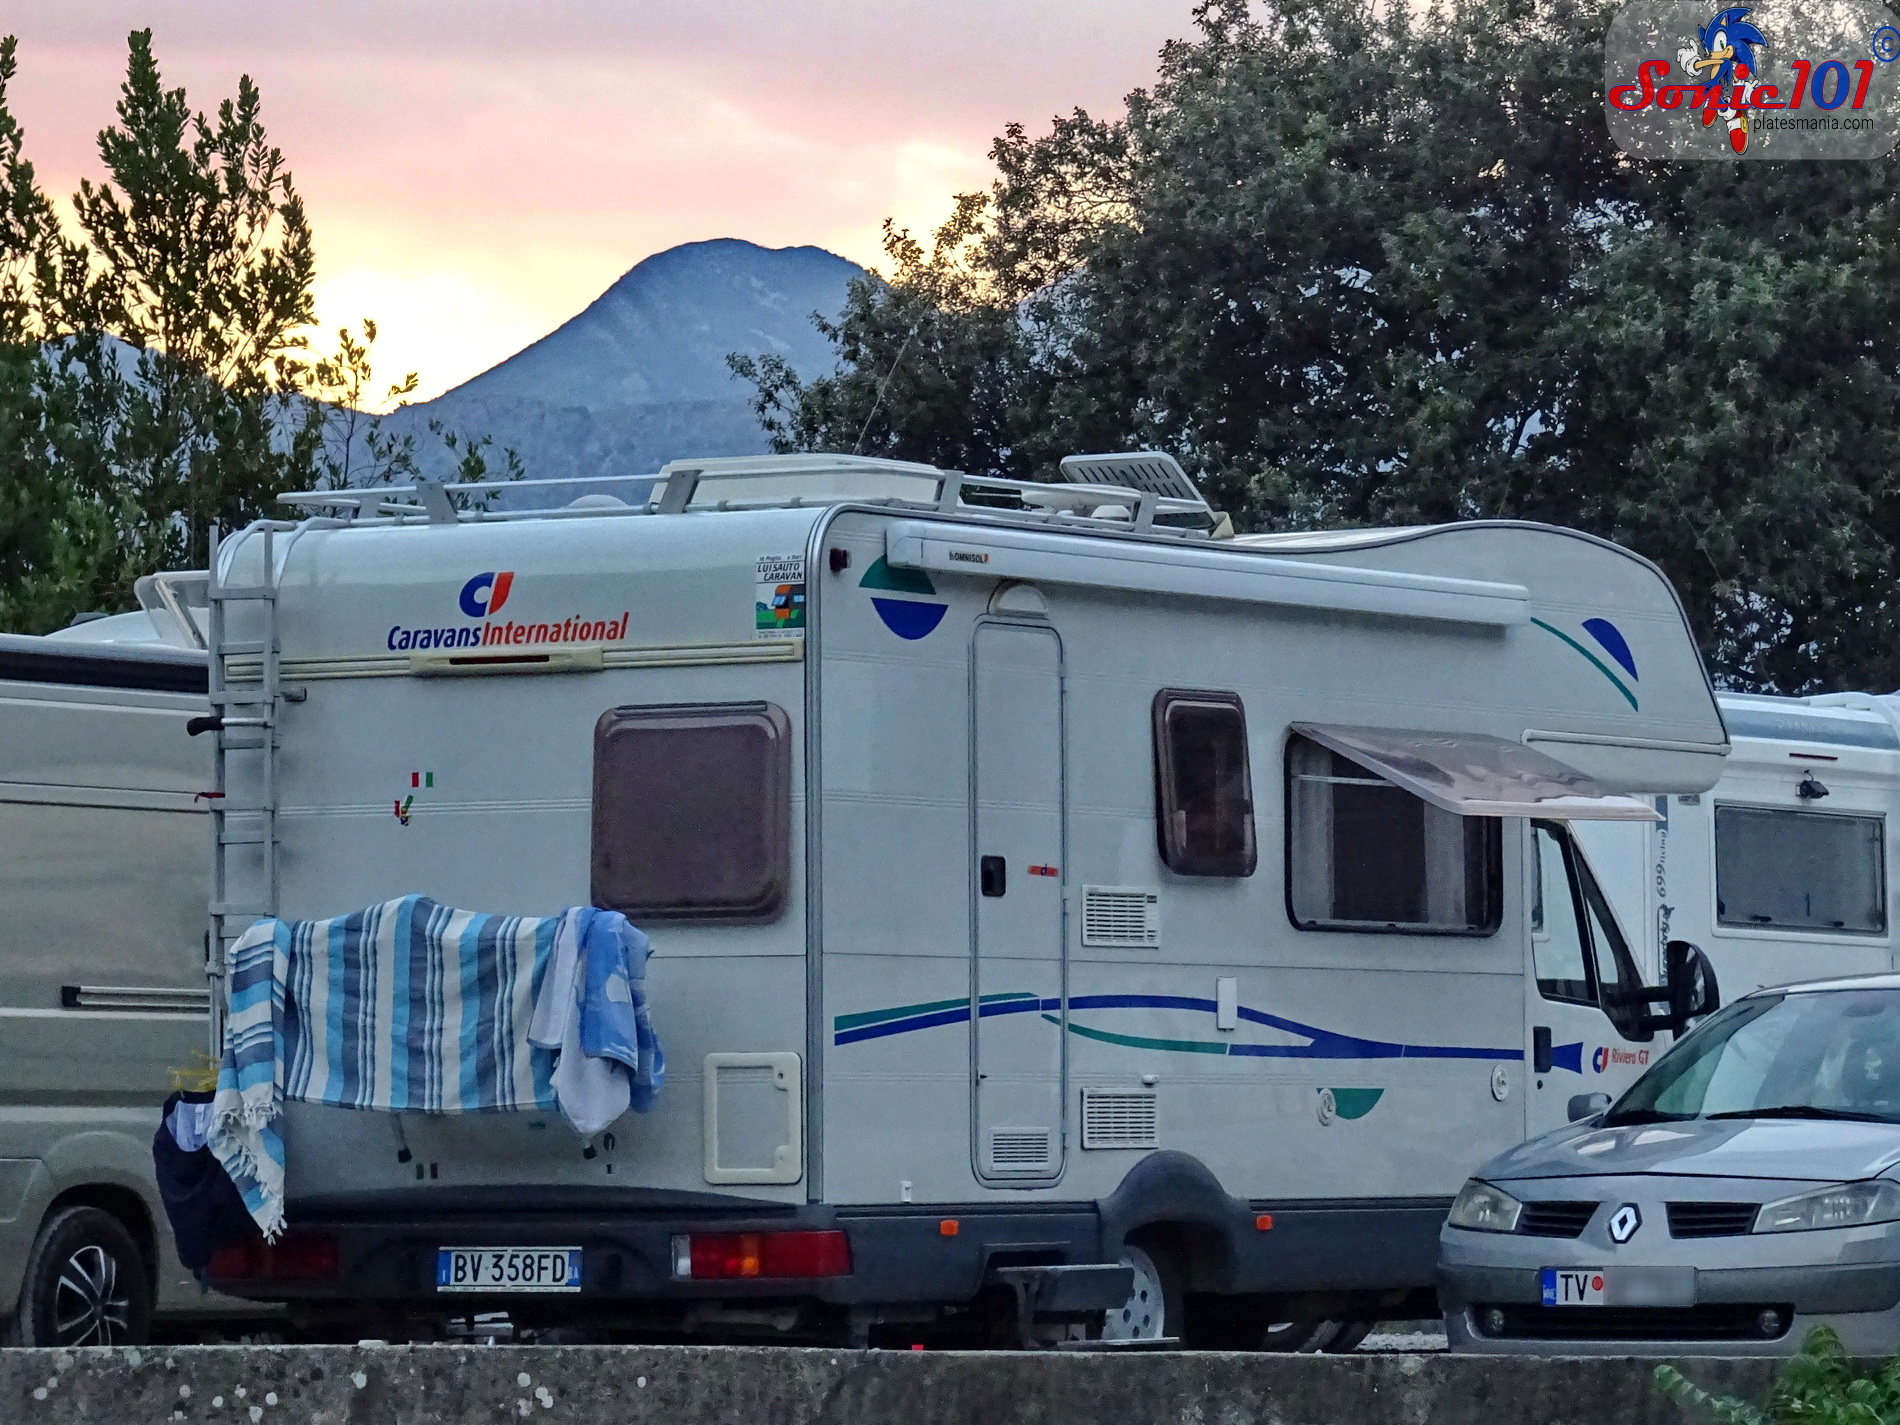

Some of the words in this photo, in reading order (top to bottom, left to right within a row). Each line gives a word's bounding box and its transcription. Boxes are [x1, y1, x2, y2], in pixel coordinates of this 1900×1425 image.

[763, 572, 803, 581] CARAVAN
[1638, 1049, 1649, 1064] GT
[454, 1254, 482, 1282] BV
[491, 1254, 566, 1282] 358FD
[1560, 1274, 1588, 1301] TV
